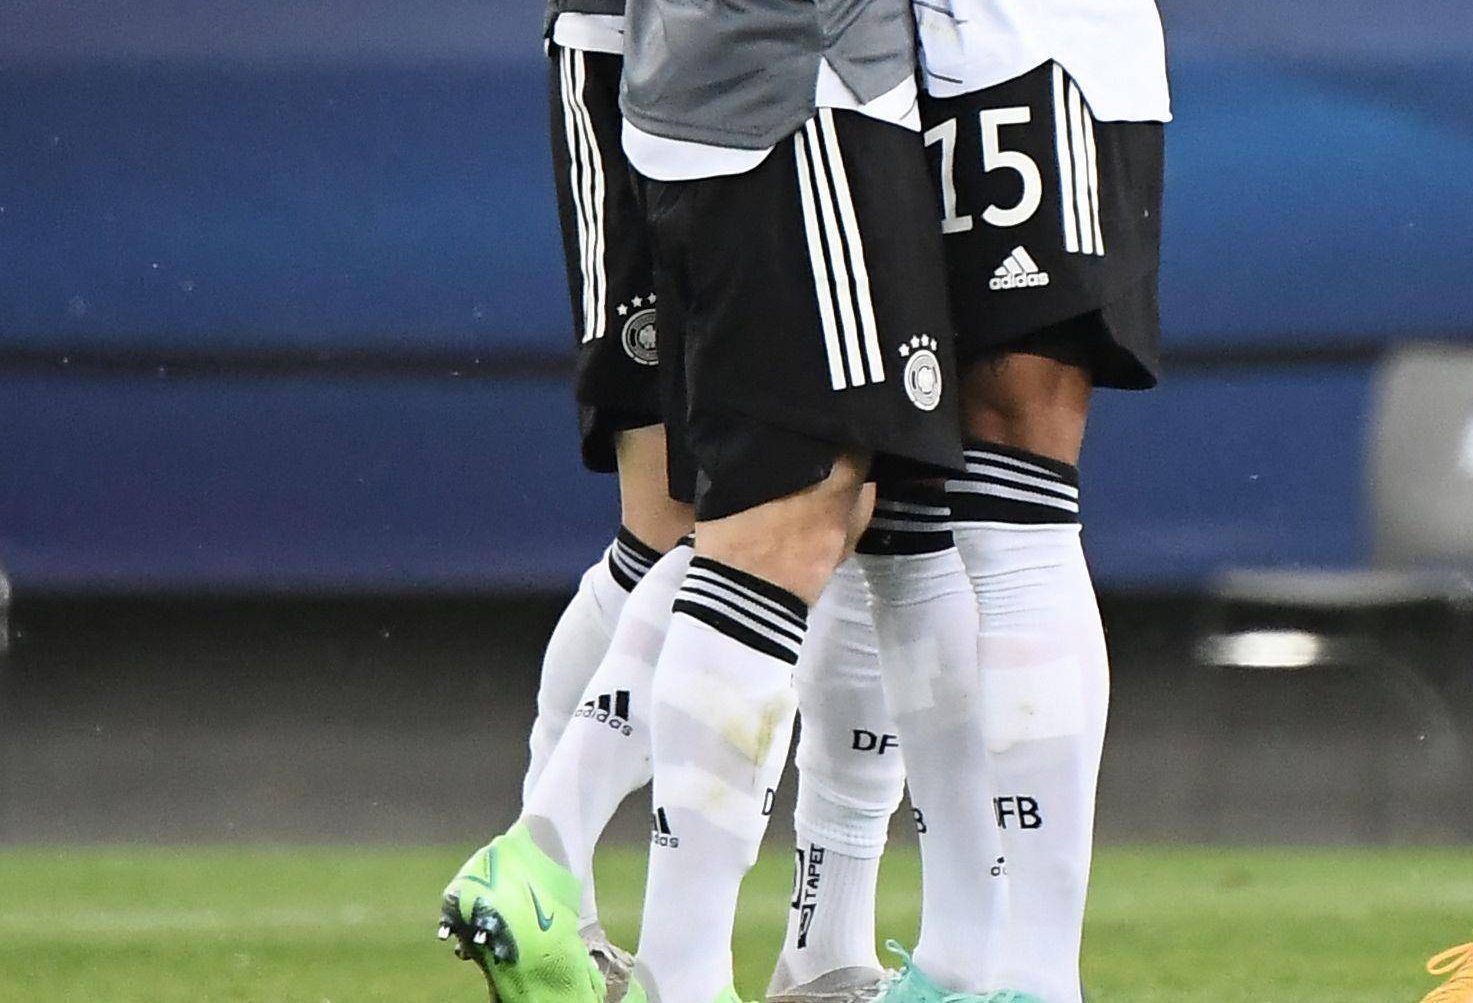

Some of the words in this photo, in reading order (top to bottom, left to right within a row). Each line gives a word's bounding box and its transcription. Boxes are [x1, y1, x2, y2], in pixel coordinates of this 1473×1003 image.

[924, 106, 1042, 234] 15
[989, 272, 1049, 290] adidas
[852, 729, 899, 755] DF
[993, 796, 1042, 829] FB
